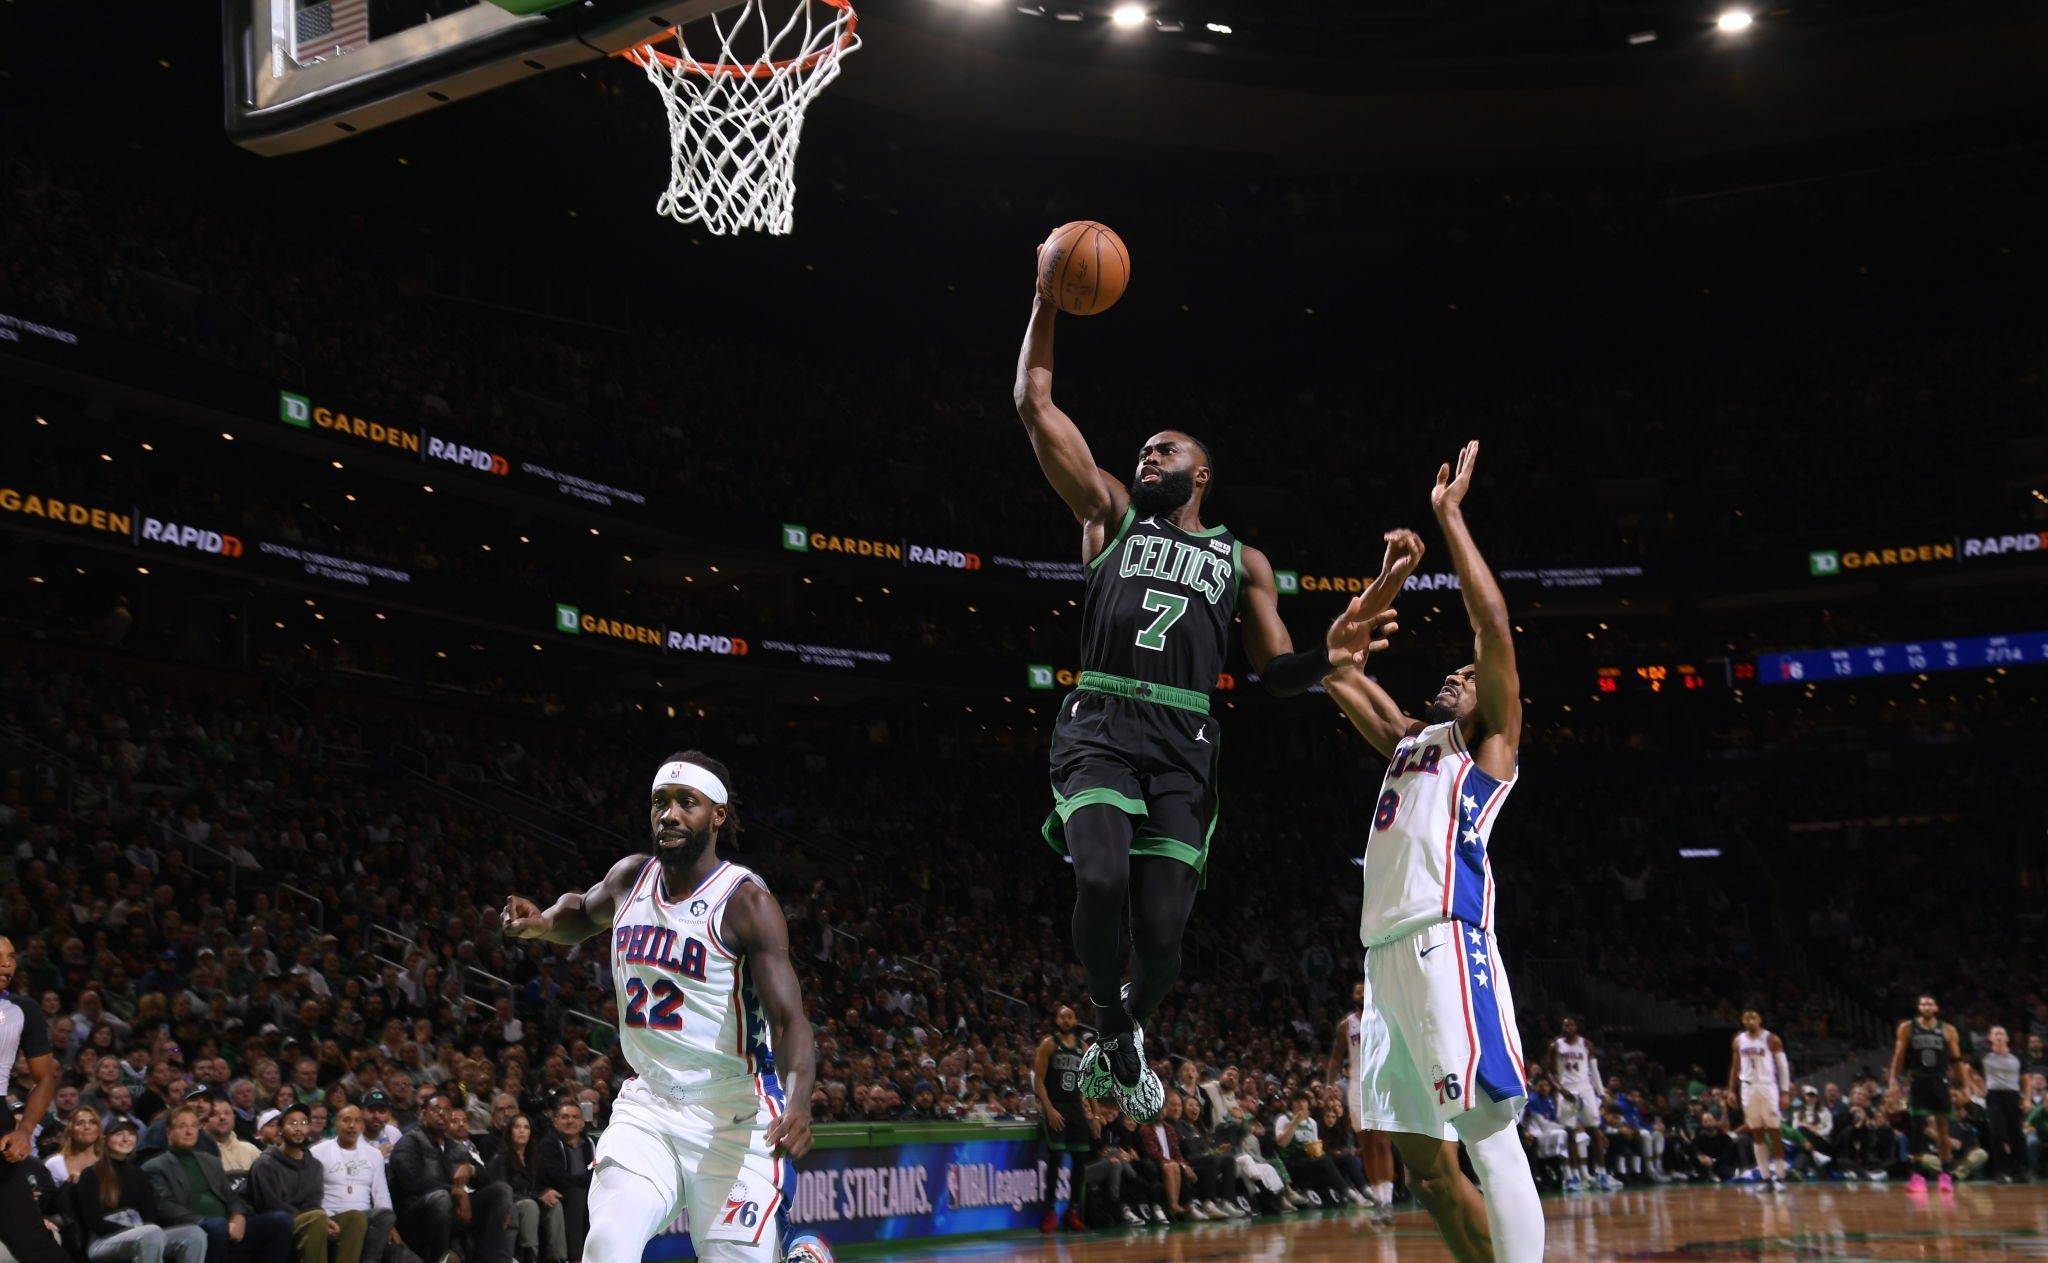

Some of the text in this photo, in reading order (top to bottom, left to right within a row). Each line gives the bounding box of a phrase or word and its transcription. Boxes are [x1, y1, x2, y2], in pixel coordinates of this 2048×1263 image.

[281, 394, 309, 423] TD
[313, 406, 420, 452] GARDEN
[0, 488, 131, 535] GARDEN
[784, 527, 807, 548] TD
[810, 532, 901, 560] GARDEN
[1812, 553, 1838, 573] TD
[1842, 544, 1954, 569] GARDEN
[1119, 534, 1232, 605] CELTICS
[1275, 573, 1462, 592] TD GARD RAPI
[557, 606, 579, 630] TD
[580, 613, 662, 647] GARDEN
[1135, 588, 1189, 651] 7
[1374, 788, 1400, 832] 8
[616, 925, 707, 983] PHILA
[625, 977, 684, 1031] 22
[1433, 1077, 1462, 1105] 76
[723, 1198, 759, 1229] 76
[842, 1164, 933, 1221] STREAMS.
